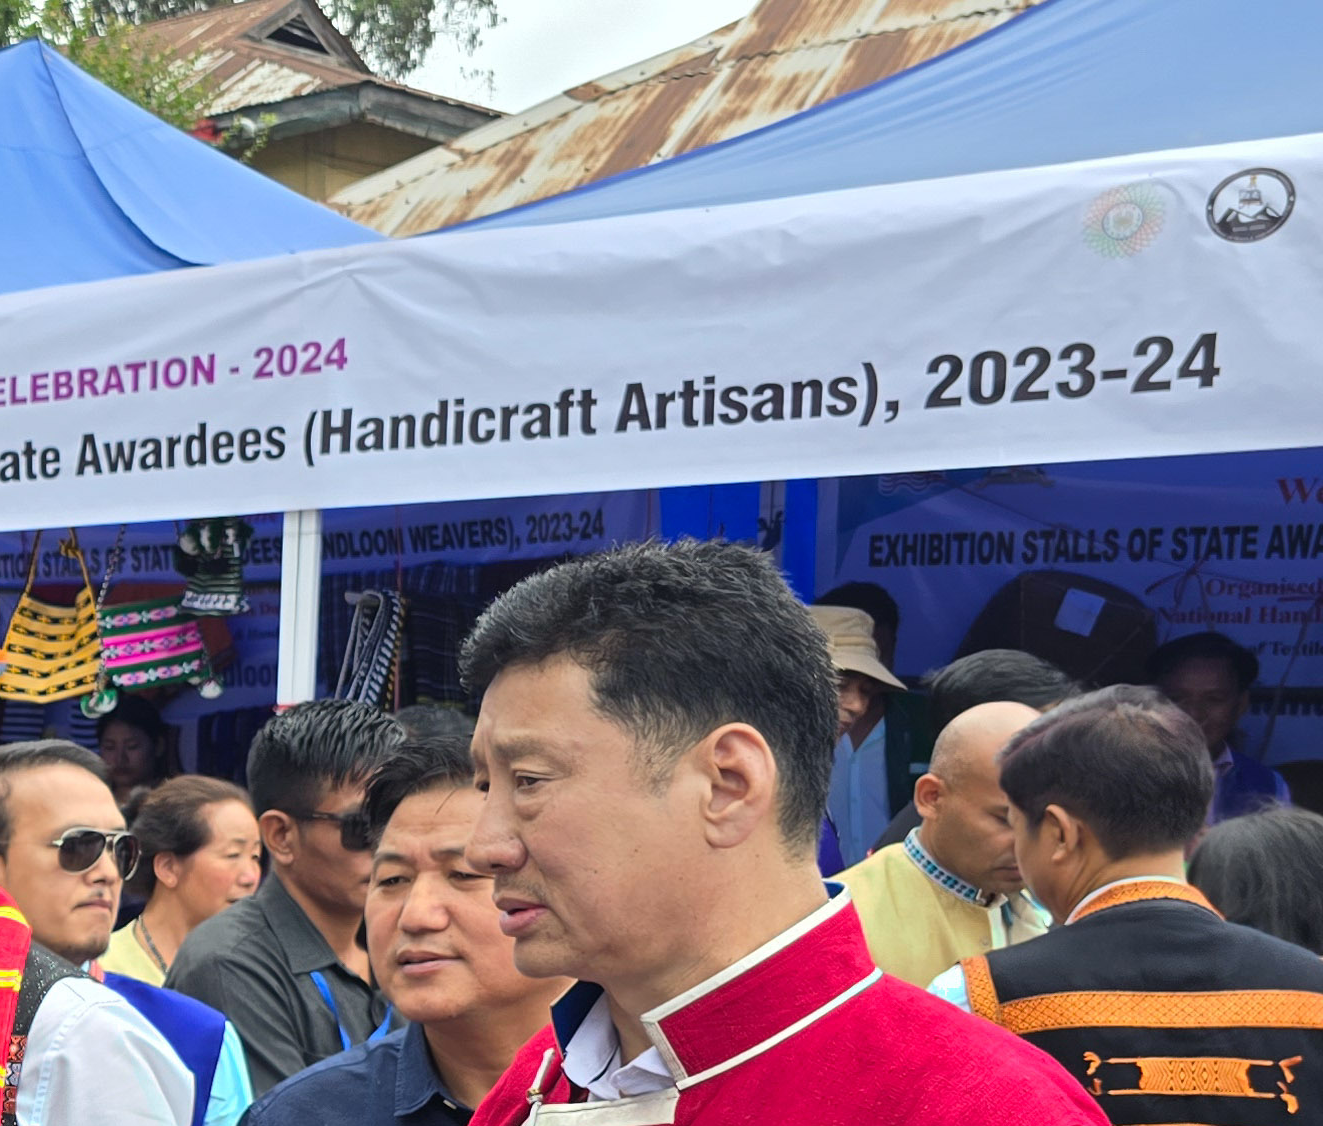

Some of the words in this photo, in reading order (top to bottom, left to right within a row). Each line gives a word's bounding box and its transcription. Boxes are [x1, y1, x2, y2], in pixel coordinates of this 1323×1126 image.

[253, 336, 349, 381] 2024
[75, 419, 287, 476] Awardees
[304, 385, 598, 467] (Handicraft
[614, 361, 901, 433] Artisans),
[924, 331, 1221, 409] 2023-24
[408, 516, 520, 553] WEAVERS),
[526, 508, 604, 546] 2023-24
[868, 530, 1015, 568] EXHIBITION
[1021, 524, 1119, 565] STALLS
[1128, 527, 1162, 563] OF
[1171, 525, 1258, 562] STATE
